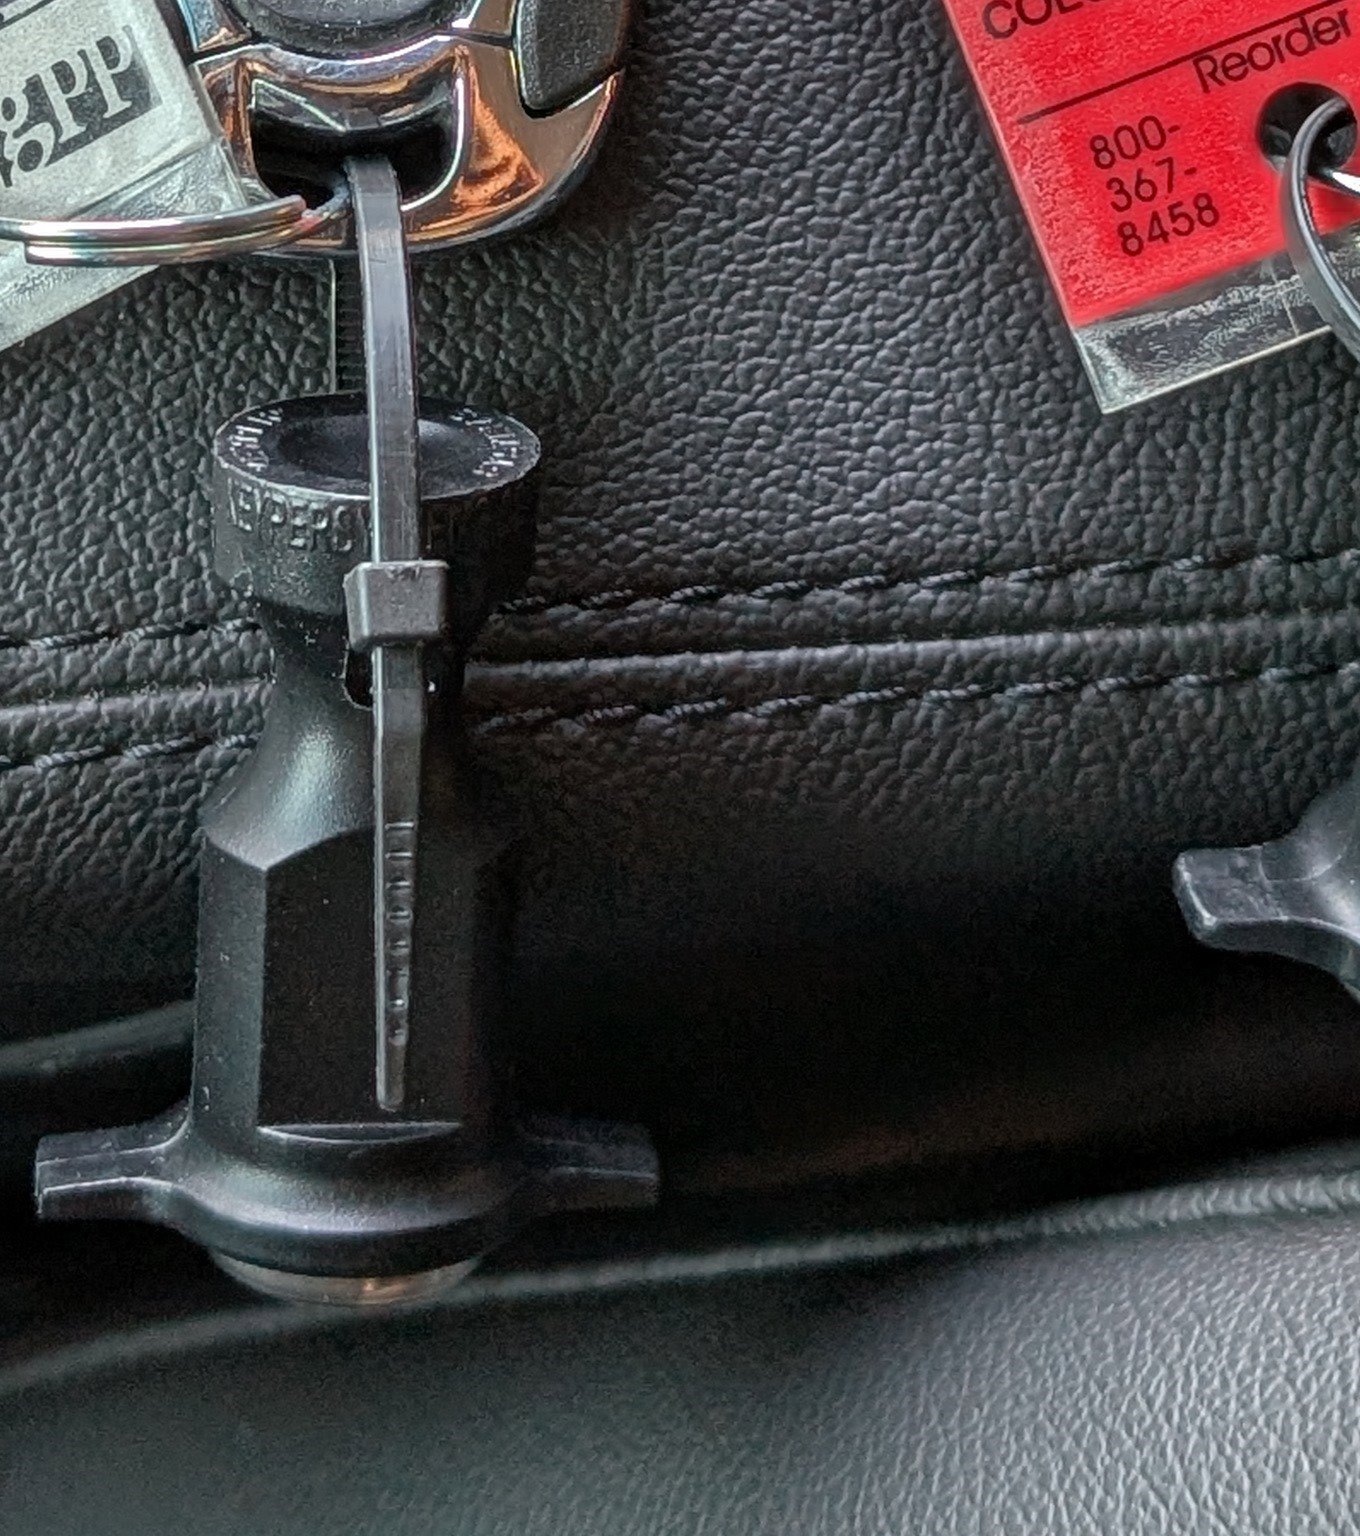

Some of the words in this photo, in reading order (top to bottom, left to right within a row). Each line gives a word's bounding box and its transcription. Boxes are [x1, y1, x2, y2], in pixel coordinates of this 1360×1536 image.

[1193, 7, 1351, 94] Reorder
[1089, 115, 1181, 170] 800-
[1105, 158, 1197, 214] 367-
[1118, 193, 1220, 256] 8458
